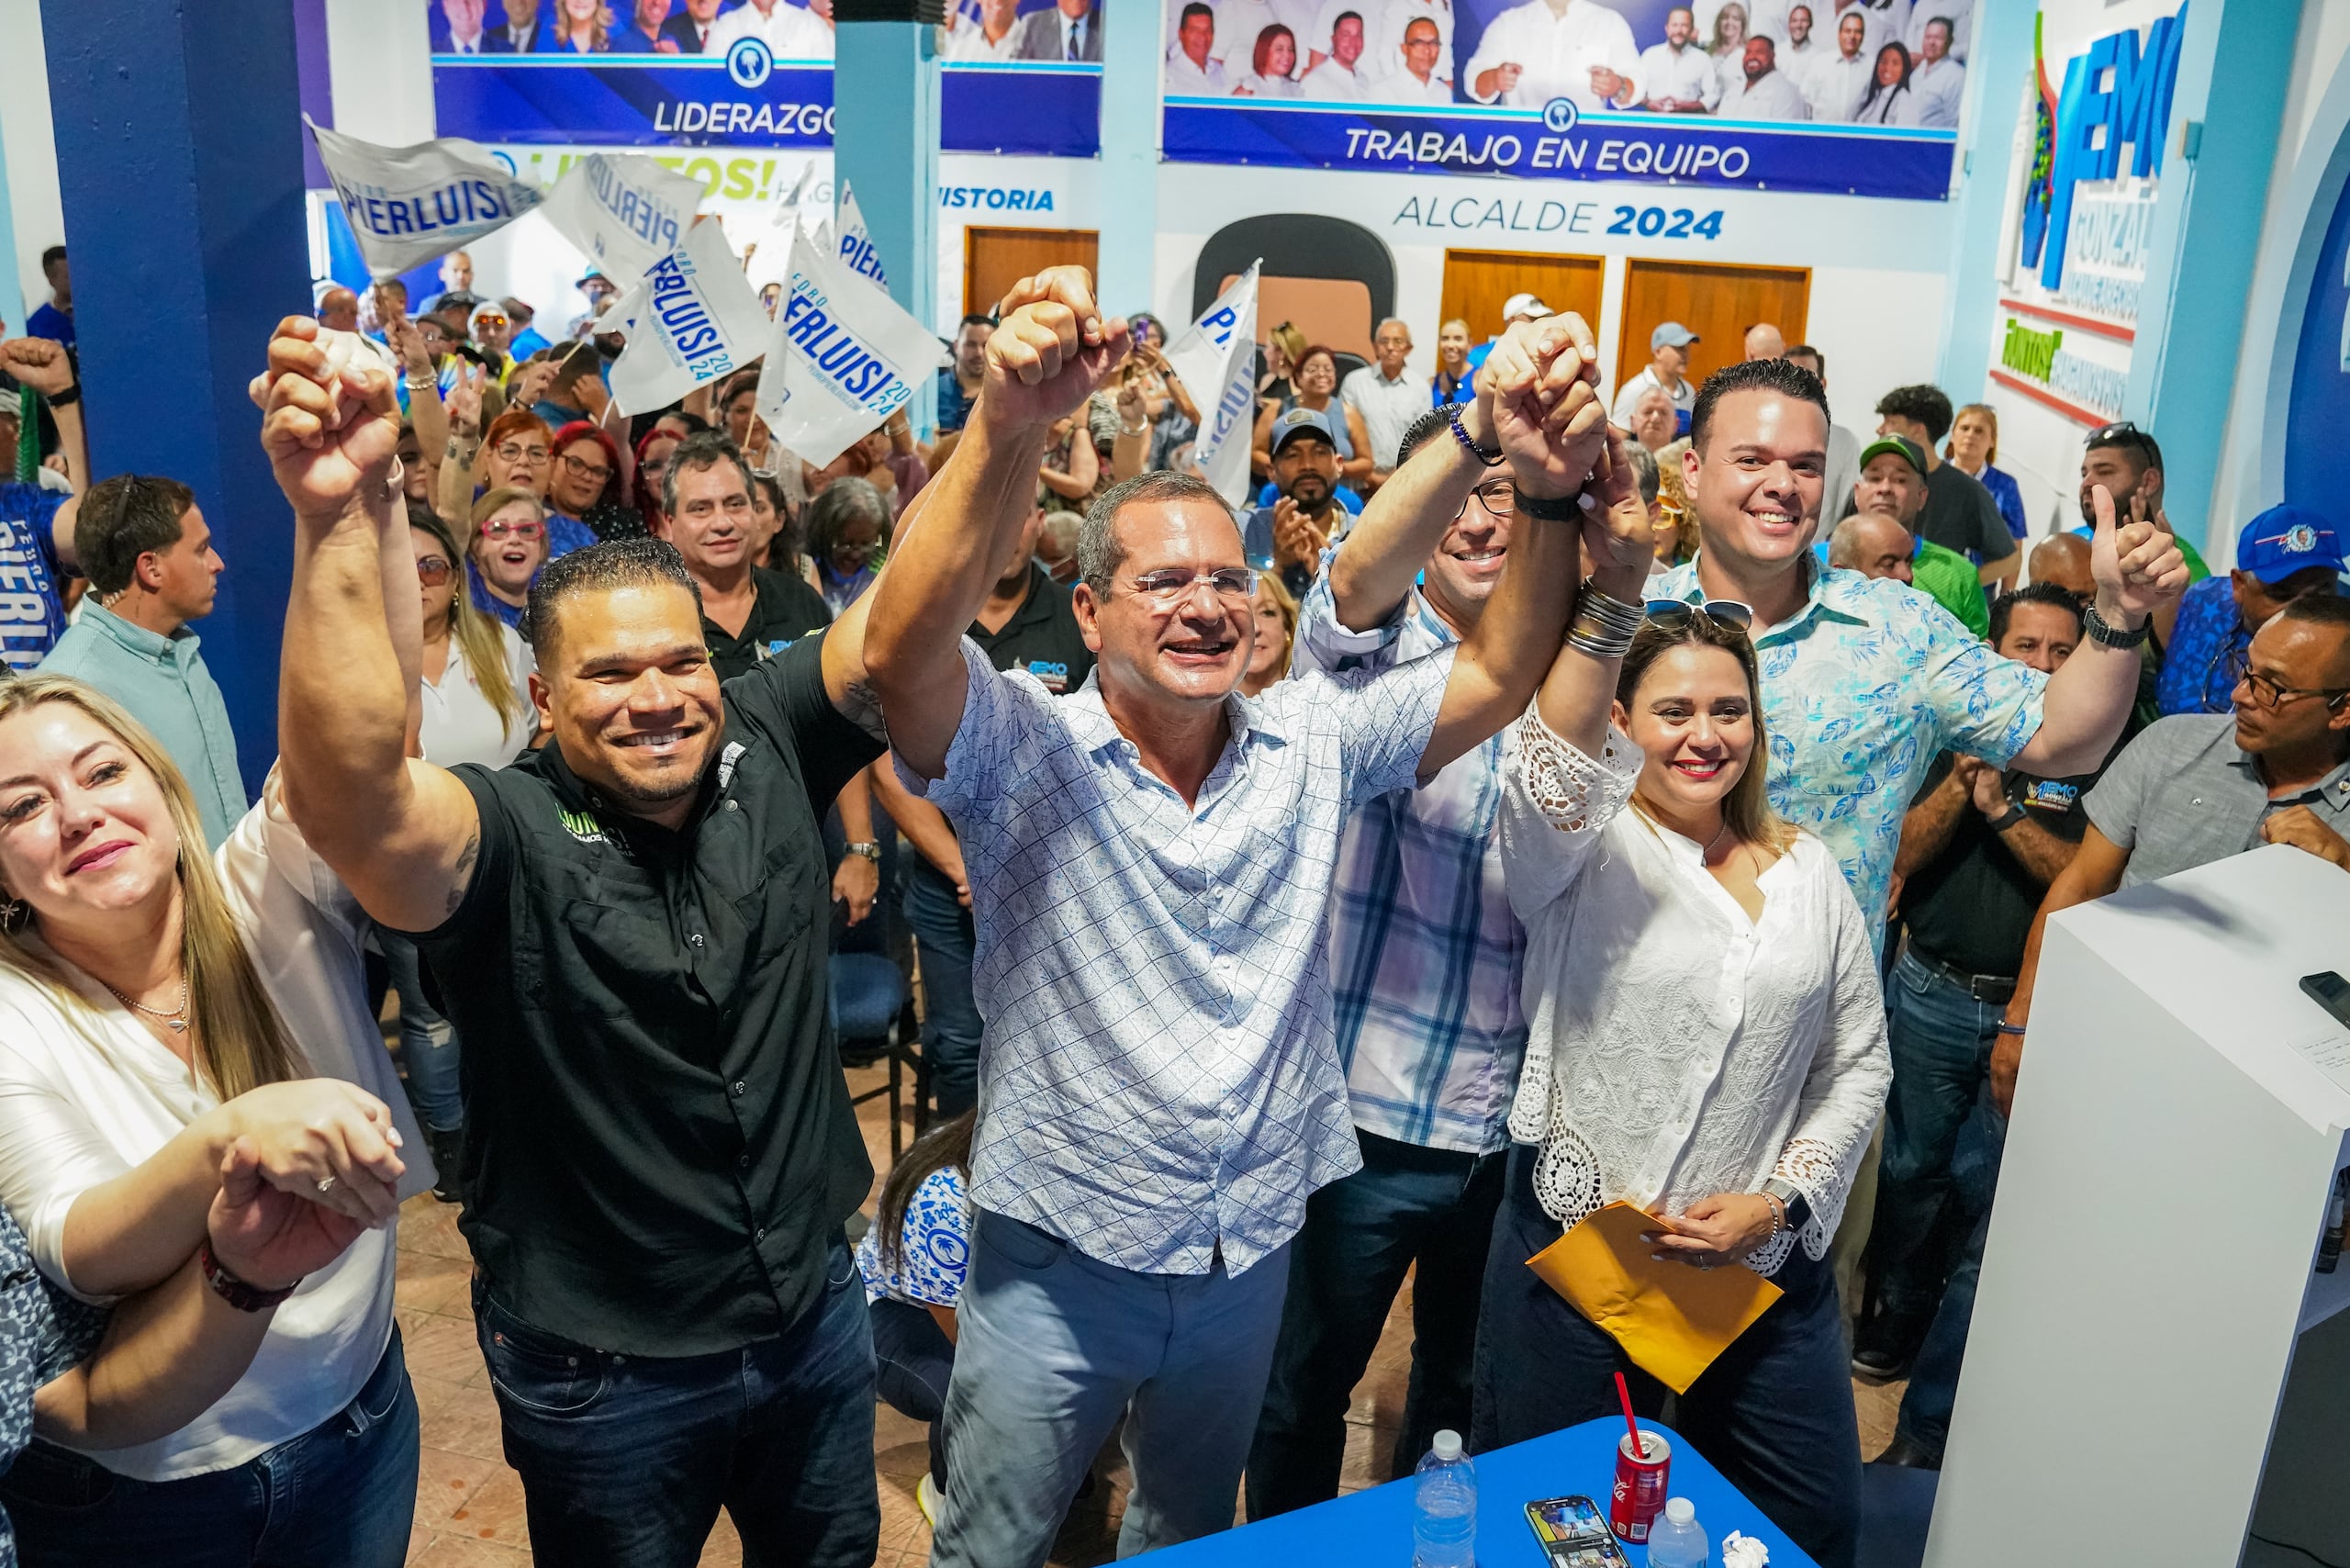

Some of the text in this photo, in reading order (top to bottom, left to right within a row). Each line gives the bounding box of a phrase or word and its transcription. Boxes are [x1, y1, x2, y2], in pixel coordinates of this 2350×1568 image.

[1345, 128, 1751, 178] TRABAJO EN EQUIPO
[939, 186, 1054, 212] ISTORIA
[1393, 196, 1724, 240] ALCALDE 2024
